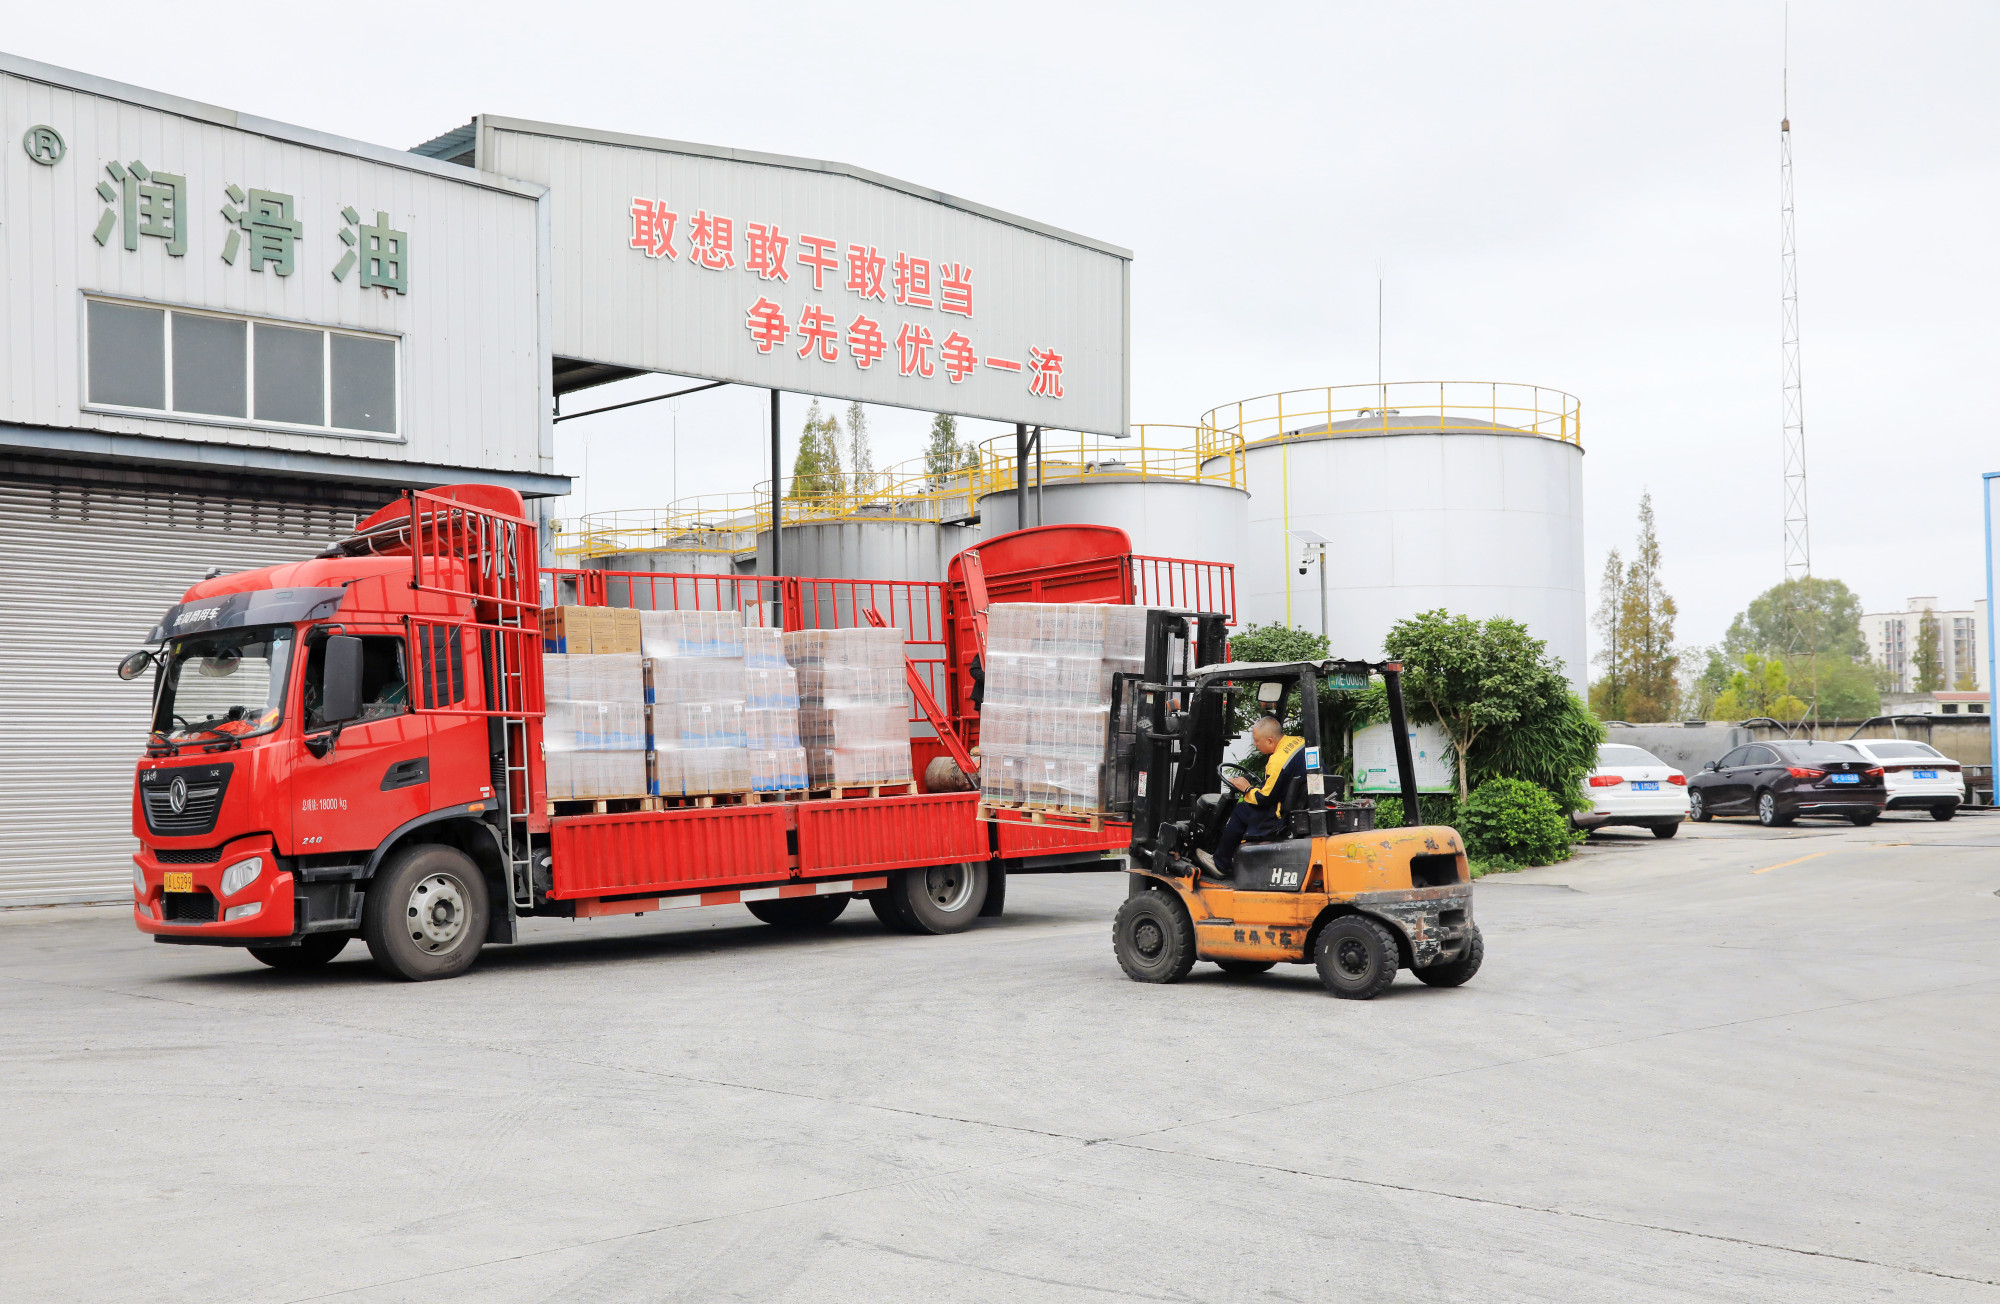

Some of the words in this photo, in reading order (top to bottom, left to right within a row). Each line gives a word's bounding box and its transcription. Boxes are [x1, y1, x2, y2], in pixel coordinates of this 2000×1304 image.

[93, 160, 407, 295] 润滑油
[630, 196, 973, 318] 敢想敢干敢担当
[746, 296, 1064, 399] 争先争优争一流
[302, 836, 323, 845] 240
[319, 798, 337, 810] 18000
[339, 796, 347, 811] kg
